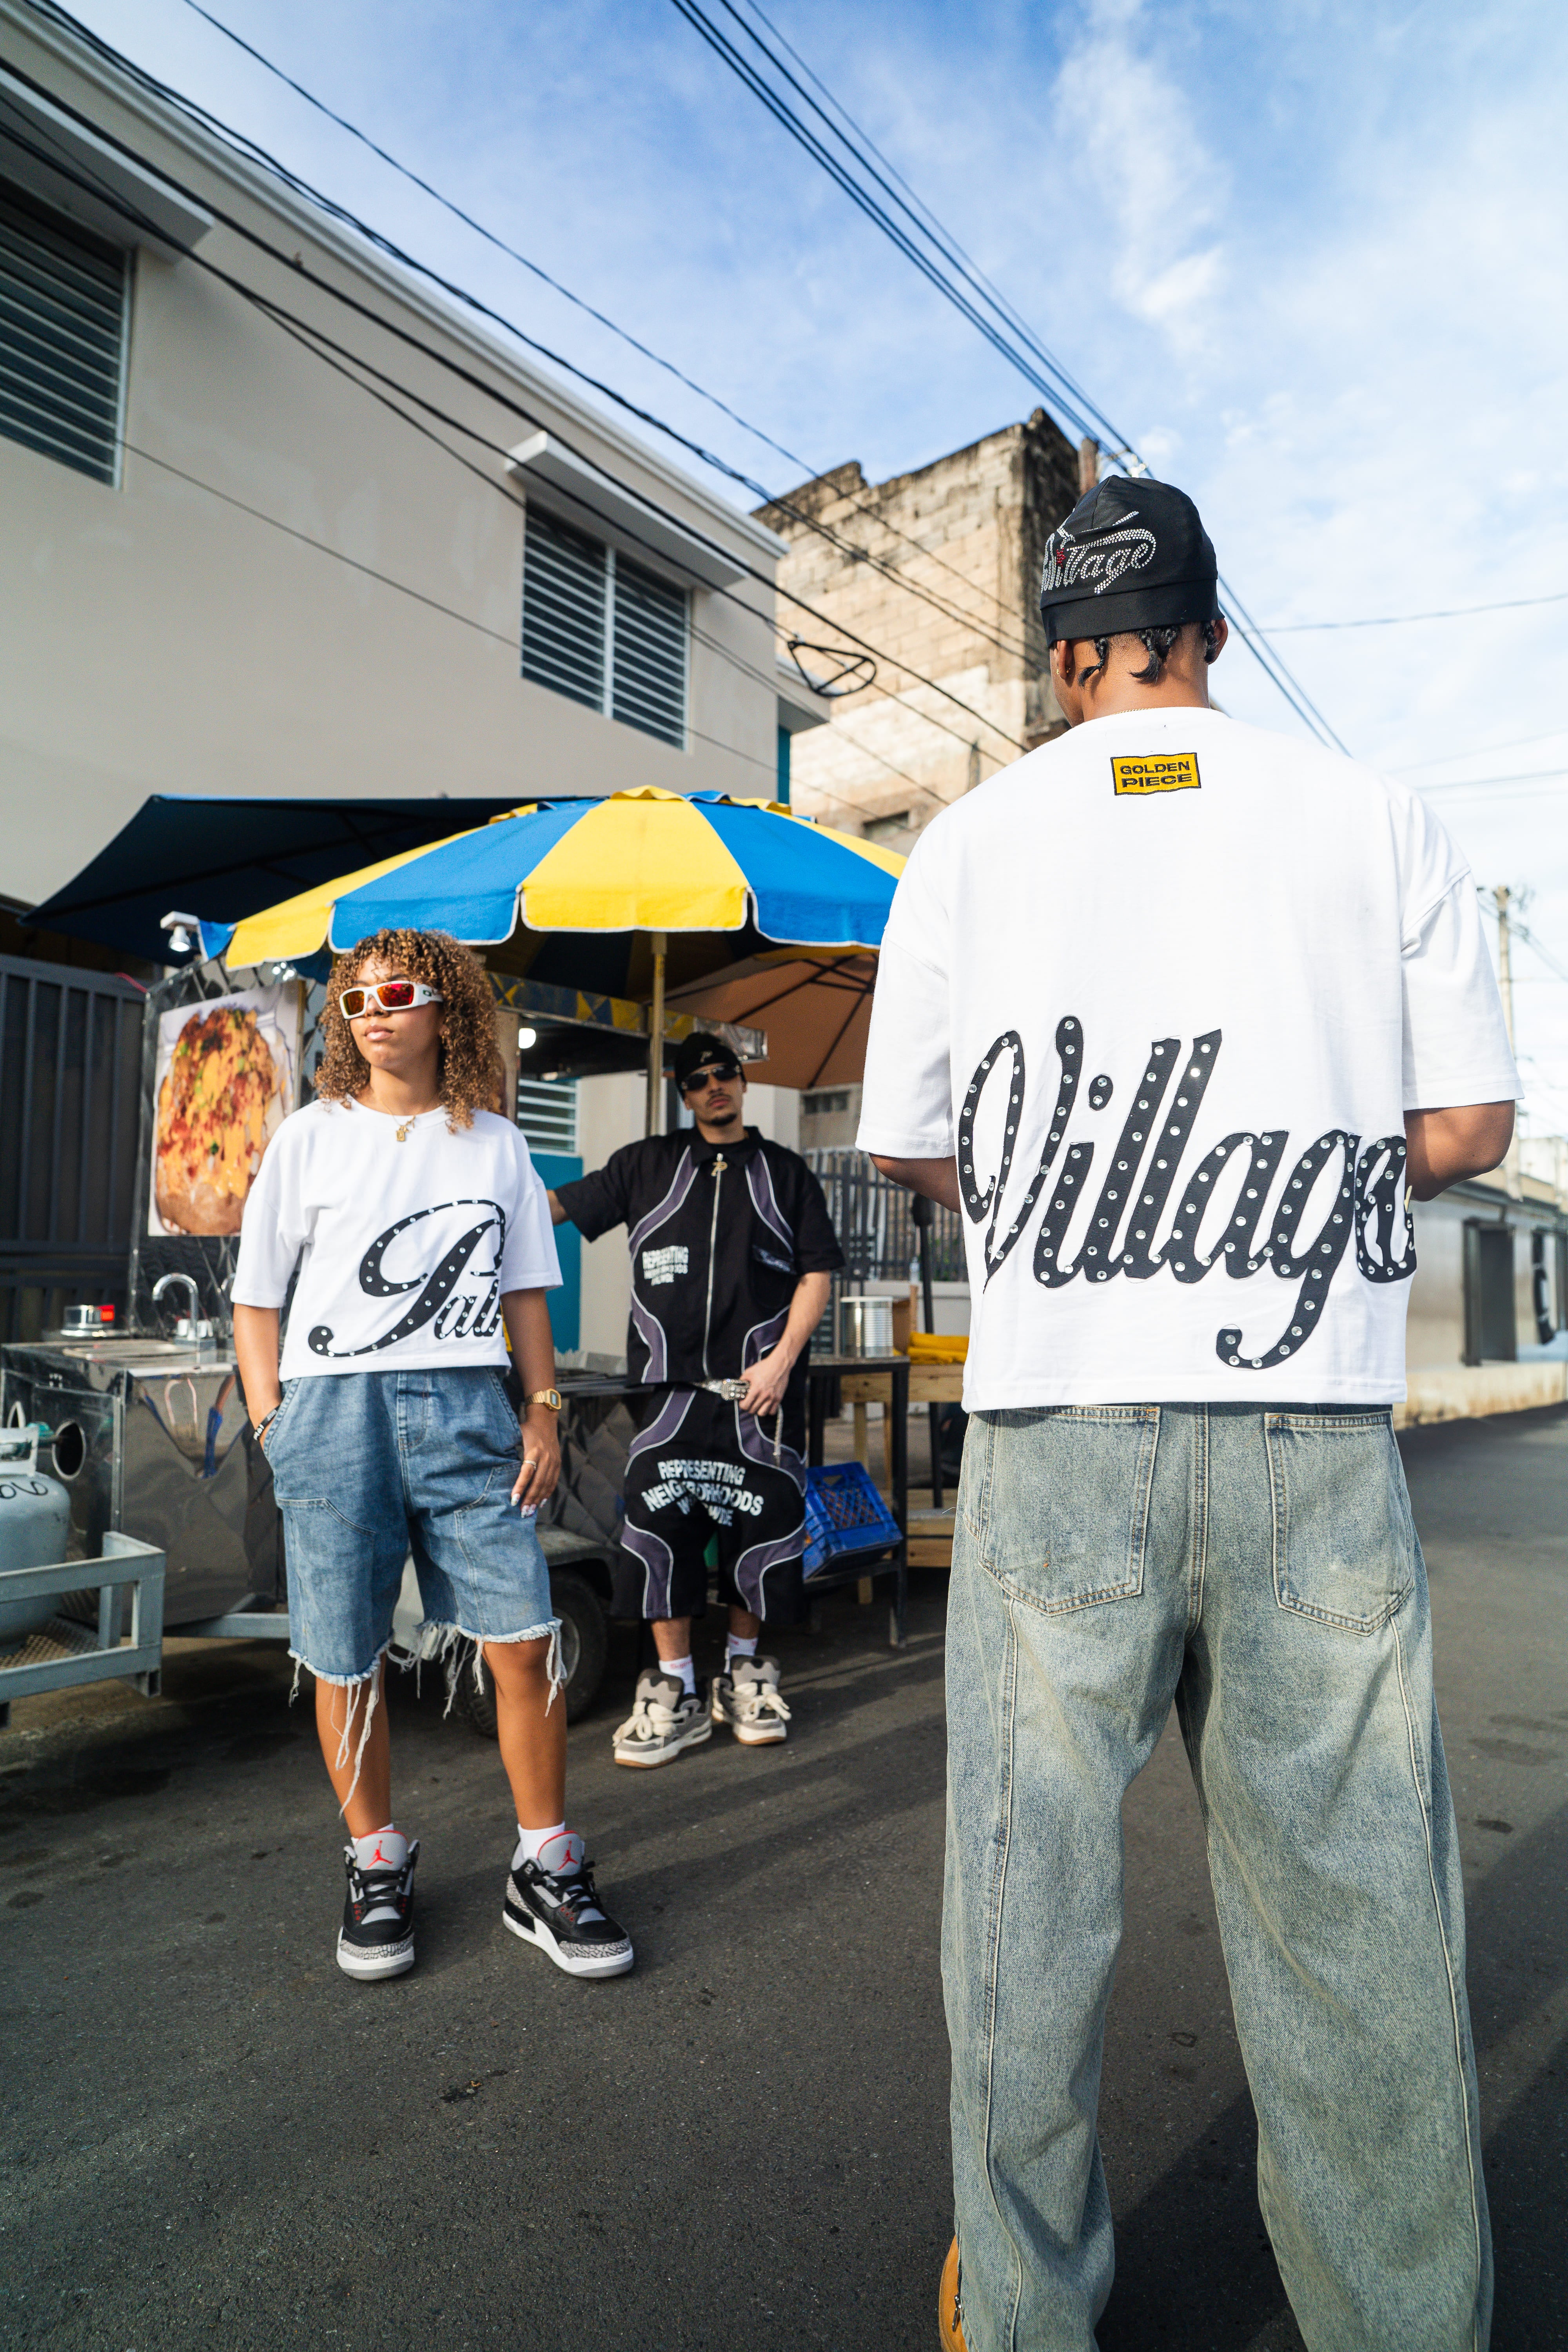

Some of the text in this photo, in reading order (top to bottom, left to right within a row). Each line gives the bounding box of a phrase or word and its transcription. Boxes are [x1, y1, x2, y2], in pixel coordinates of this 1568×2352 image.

[1120, 761, 1190, 775] GOLDEN
[1122, 773, 1192, 788] PIECE
[958, 1015, 1417, 1371] Village
[641, 1479, 764, 1516] NEIGBORHOODS
